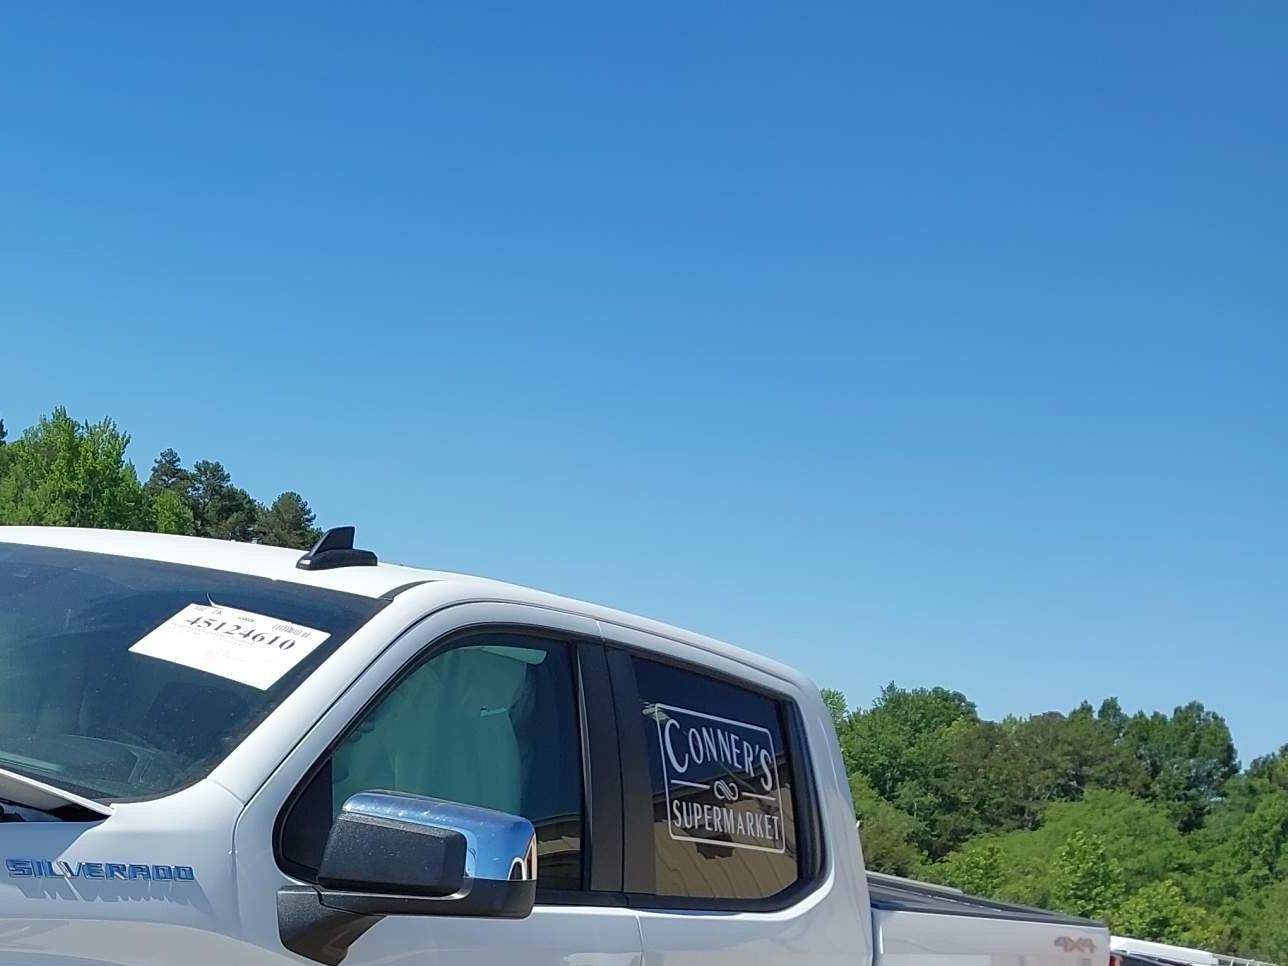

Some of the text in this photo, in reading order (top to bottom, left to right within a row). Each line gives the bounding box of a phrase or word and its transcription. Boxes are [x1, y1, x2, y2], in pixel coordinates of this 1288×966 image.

[185, 615, 297, 651] 45124610
[664, 719, 773, 792] CONNER'S
[672, 800, 780, 841] SUPERMARKET
[6, 858, 194, 881] SILVERADO
